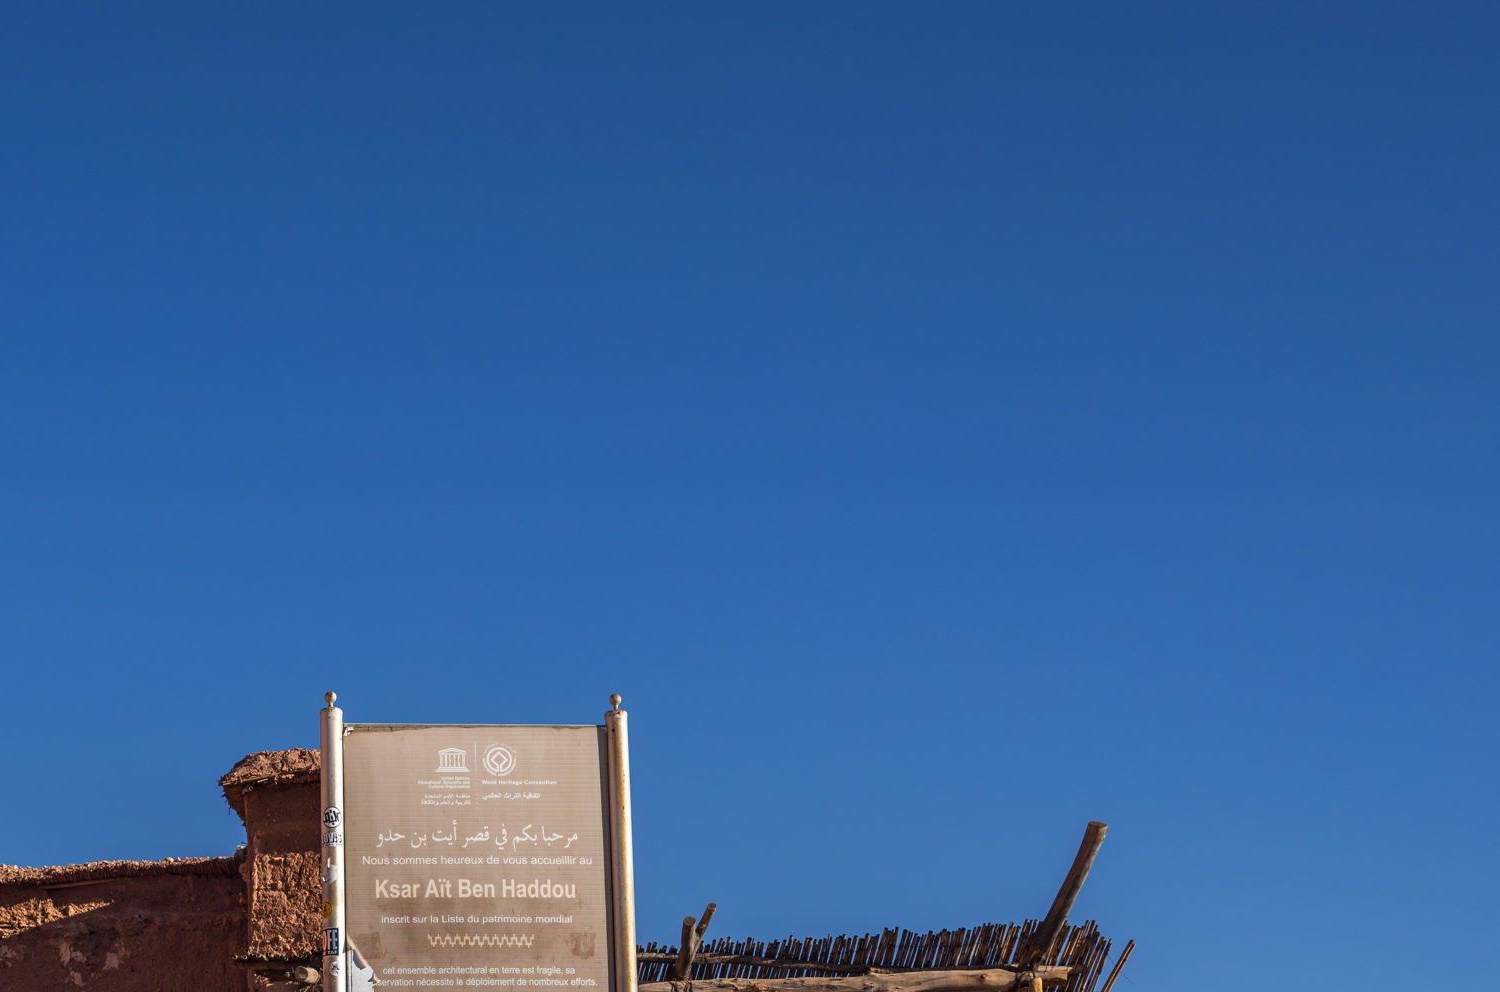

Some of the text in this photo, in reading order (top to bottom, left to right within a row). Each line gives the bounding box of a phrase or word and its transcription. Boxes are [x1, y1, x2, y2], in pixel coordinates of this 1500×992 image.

[376, 819, 578, 852] مرحبا بكم في قصر أيت بن حدو
[362, 855, 593, 865] Nous sommes heureux de vous accueillir au
[375, 878, 577, 898] Ksar Aït Ben Haddou
[381, 915, 573, 925] inscrit sur la Liste du patrimoine mondial
[383, 966, 396, 974] cet
[397, 966, 437, 974] ensemble
[439, 966, 487, 974] architectural
[536, 966, 563, 976] fragile,
[376, 978, 598, 987] servation nécessite le déploiement de nombreux efforts.
